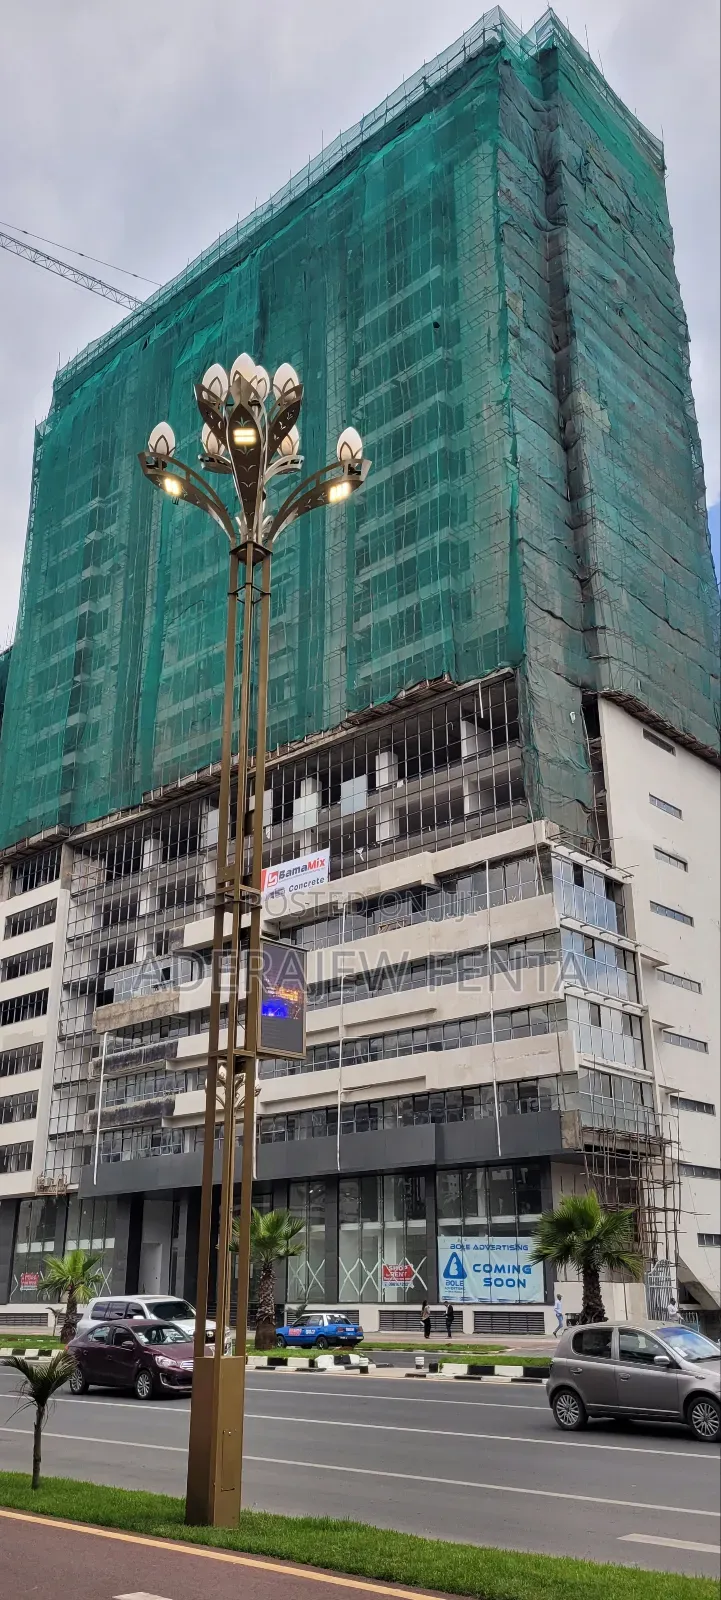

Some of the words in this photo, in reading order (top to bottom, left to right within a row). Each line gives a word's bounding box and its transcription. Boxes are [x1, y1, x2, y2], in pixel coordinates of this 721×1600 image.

[279, 858, 325, 880] BamaMix
[288, 877, 325, 892] Concrete
[473, 1244, 529, 1252] ADVERTISING
[472, 1263, 532, 1275] COMING
[483, 1277, 527, 1289] SOON
